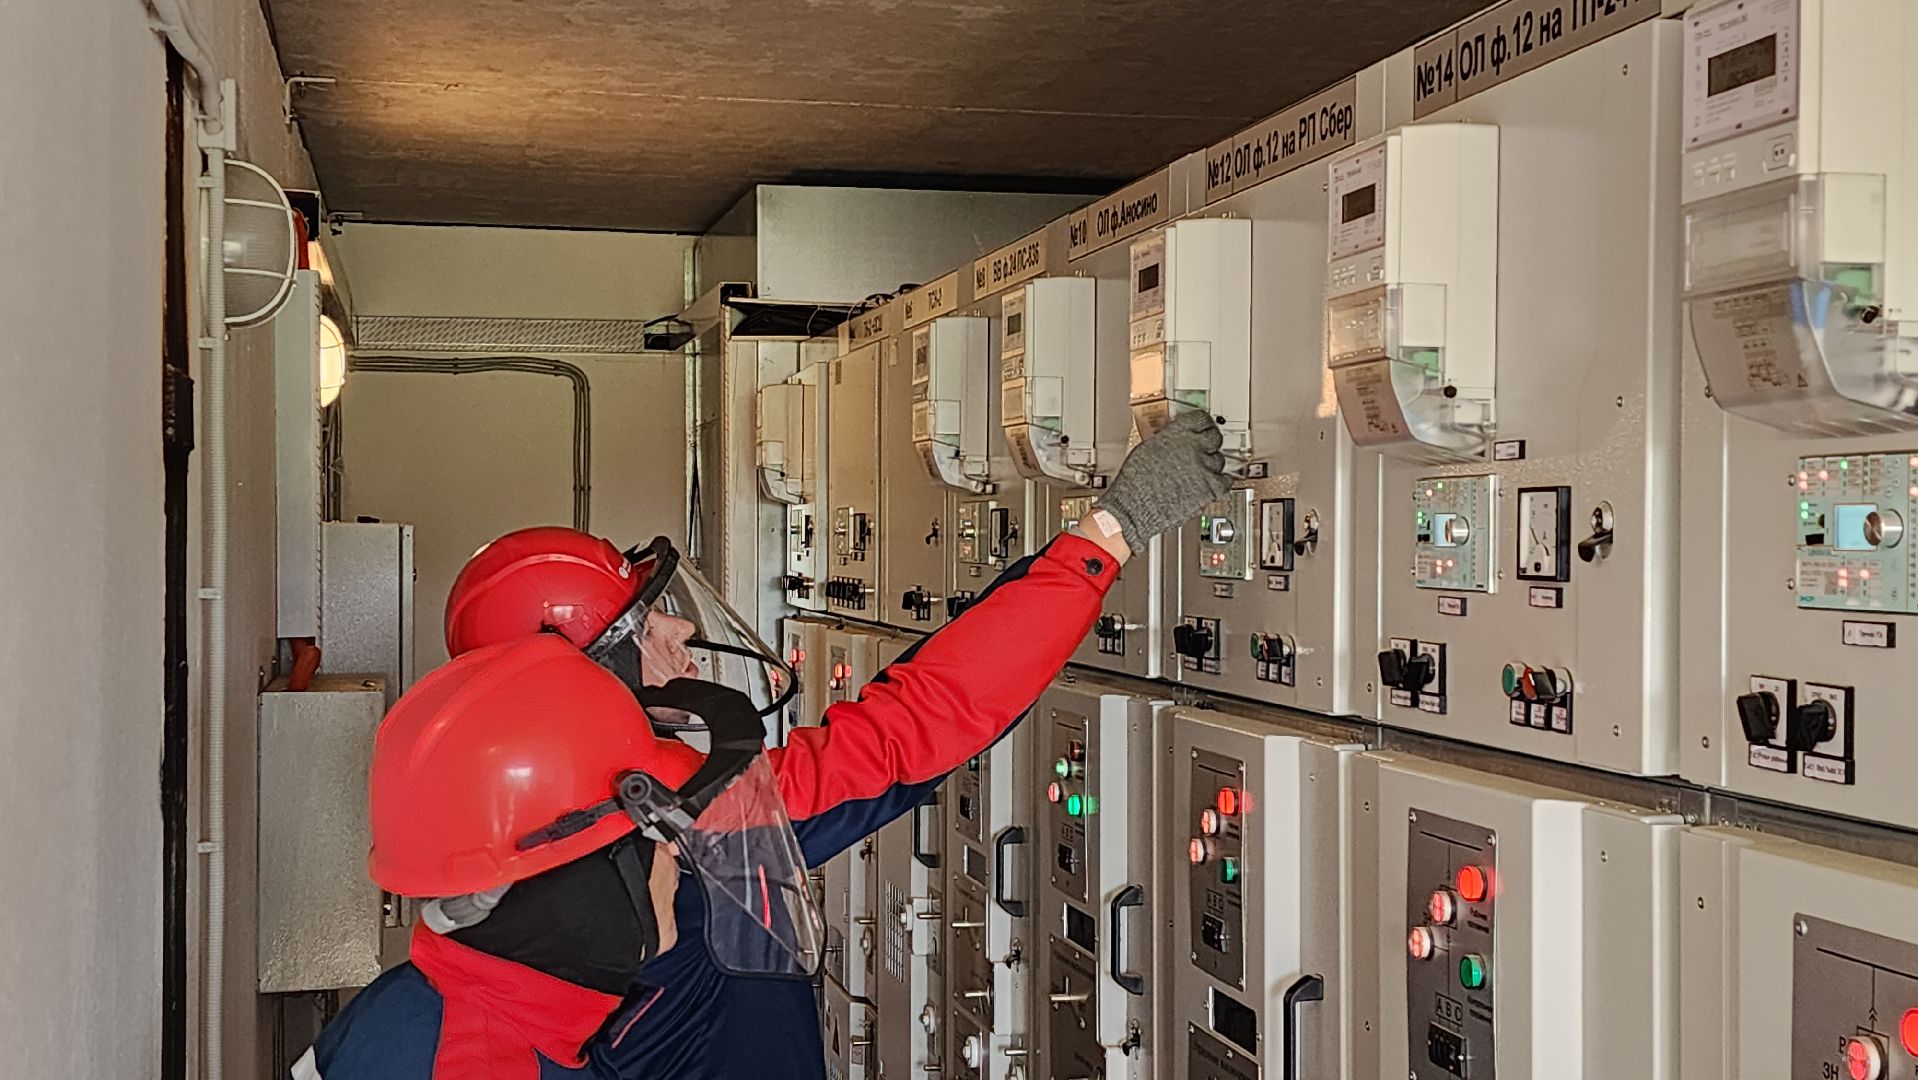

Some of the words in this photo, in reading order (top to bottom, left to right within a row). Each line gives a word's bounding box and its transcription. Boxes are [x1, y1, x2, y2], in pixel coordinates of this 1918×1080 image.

[1416, 48, 1454, 102] №14
[1459, 34, 1485, 82] ОЛ
[1490, 11, 1533, 76] ф.12
[1539, 7, 1563, 46] на
[1207, 152, 1231, 190] №12
[1234, 143, 1251, 179] ОЛ
[1253, 130, 1279, 178] ф.12
[1282, 130, 1296, 159] на
[1298, 112, 1316, 152] РП
[1319, 102, 1353, 141] Сбер
[1070, 219, 1087, 249] №10
[1097, 208, 1110, 238] ОЛ
